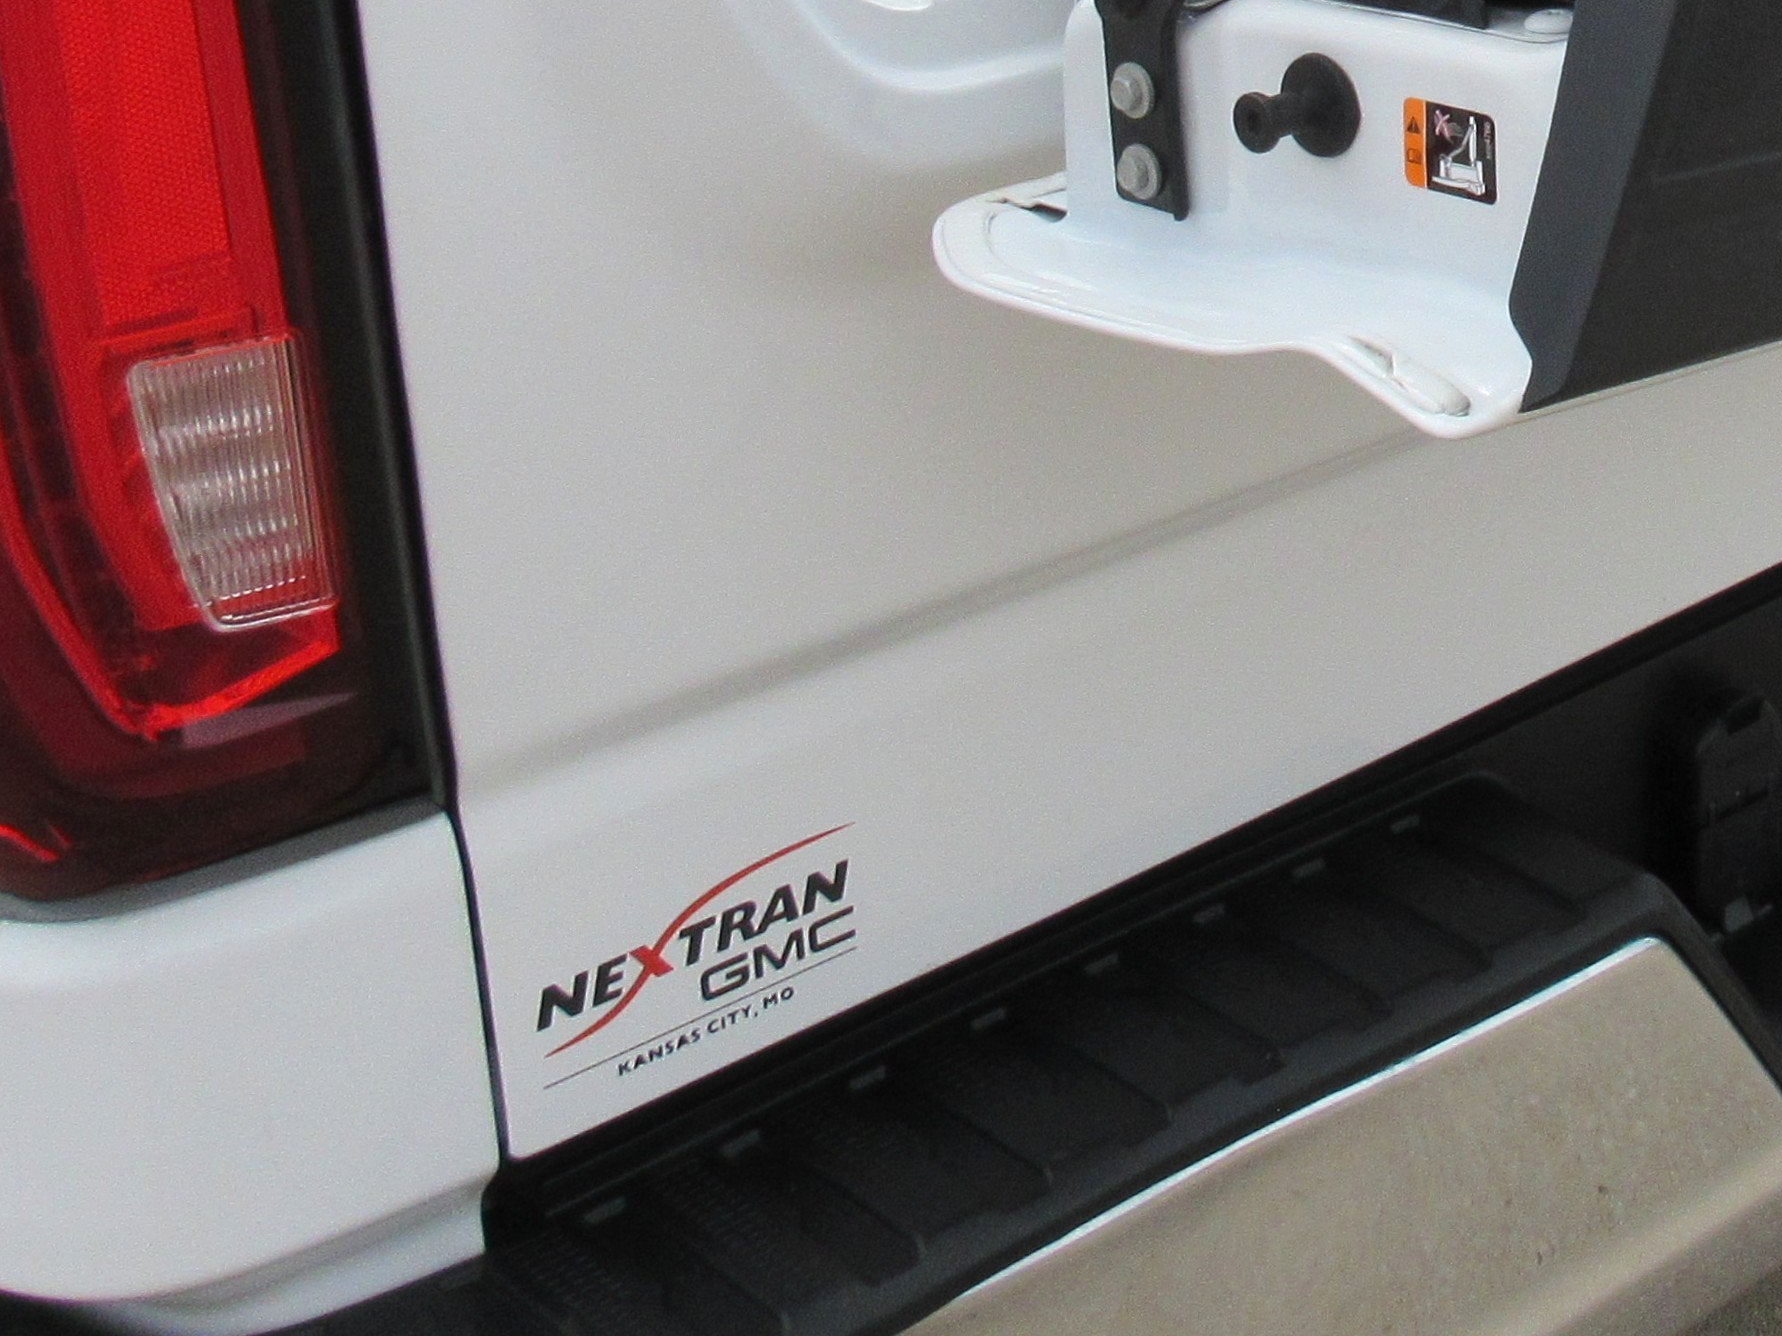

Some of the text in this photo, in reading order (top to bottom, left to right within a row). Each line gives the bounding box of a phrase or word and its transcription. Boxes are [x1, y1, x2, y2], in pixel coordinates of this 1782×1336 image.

[536, 859, 848, 1032] NEXTRAN
[699, 905, 856, 1001] GMC
[618, 987, 795, 1076] KANSAS CITY, MO
